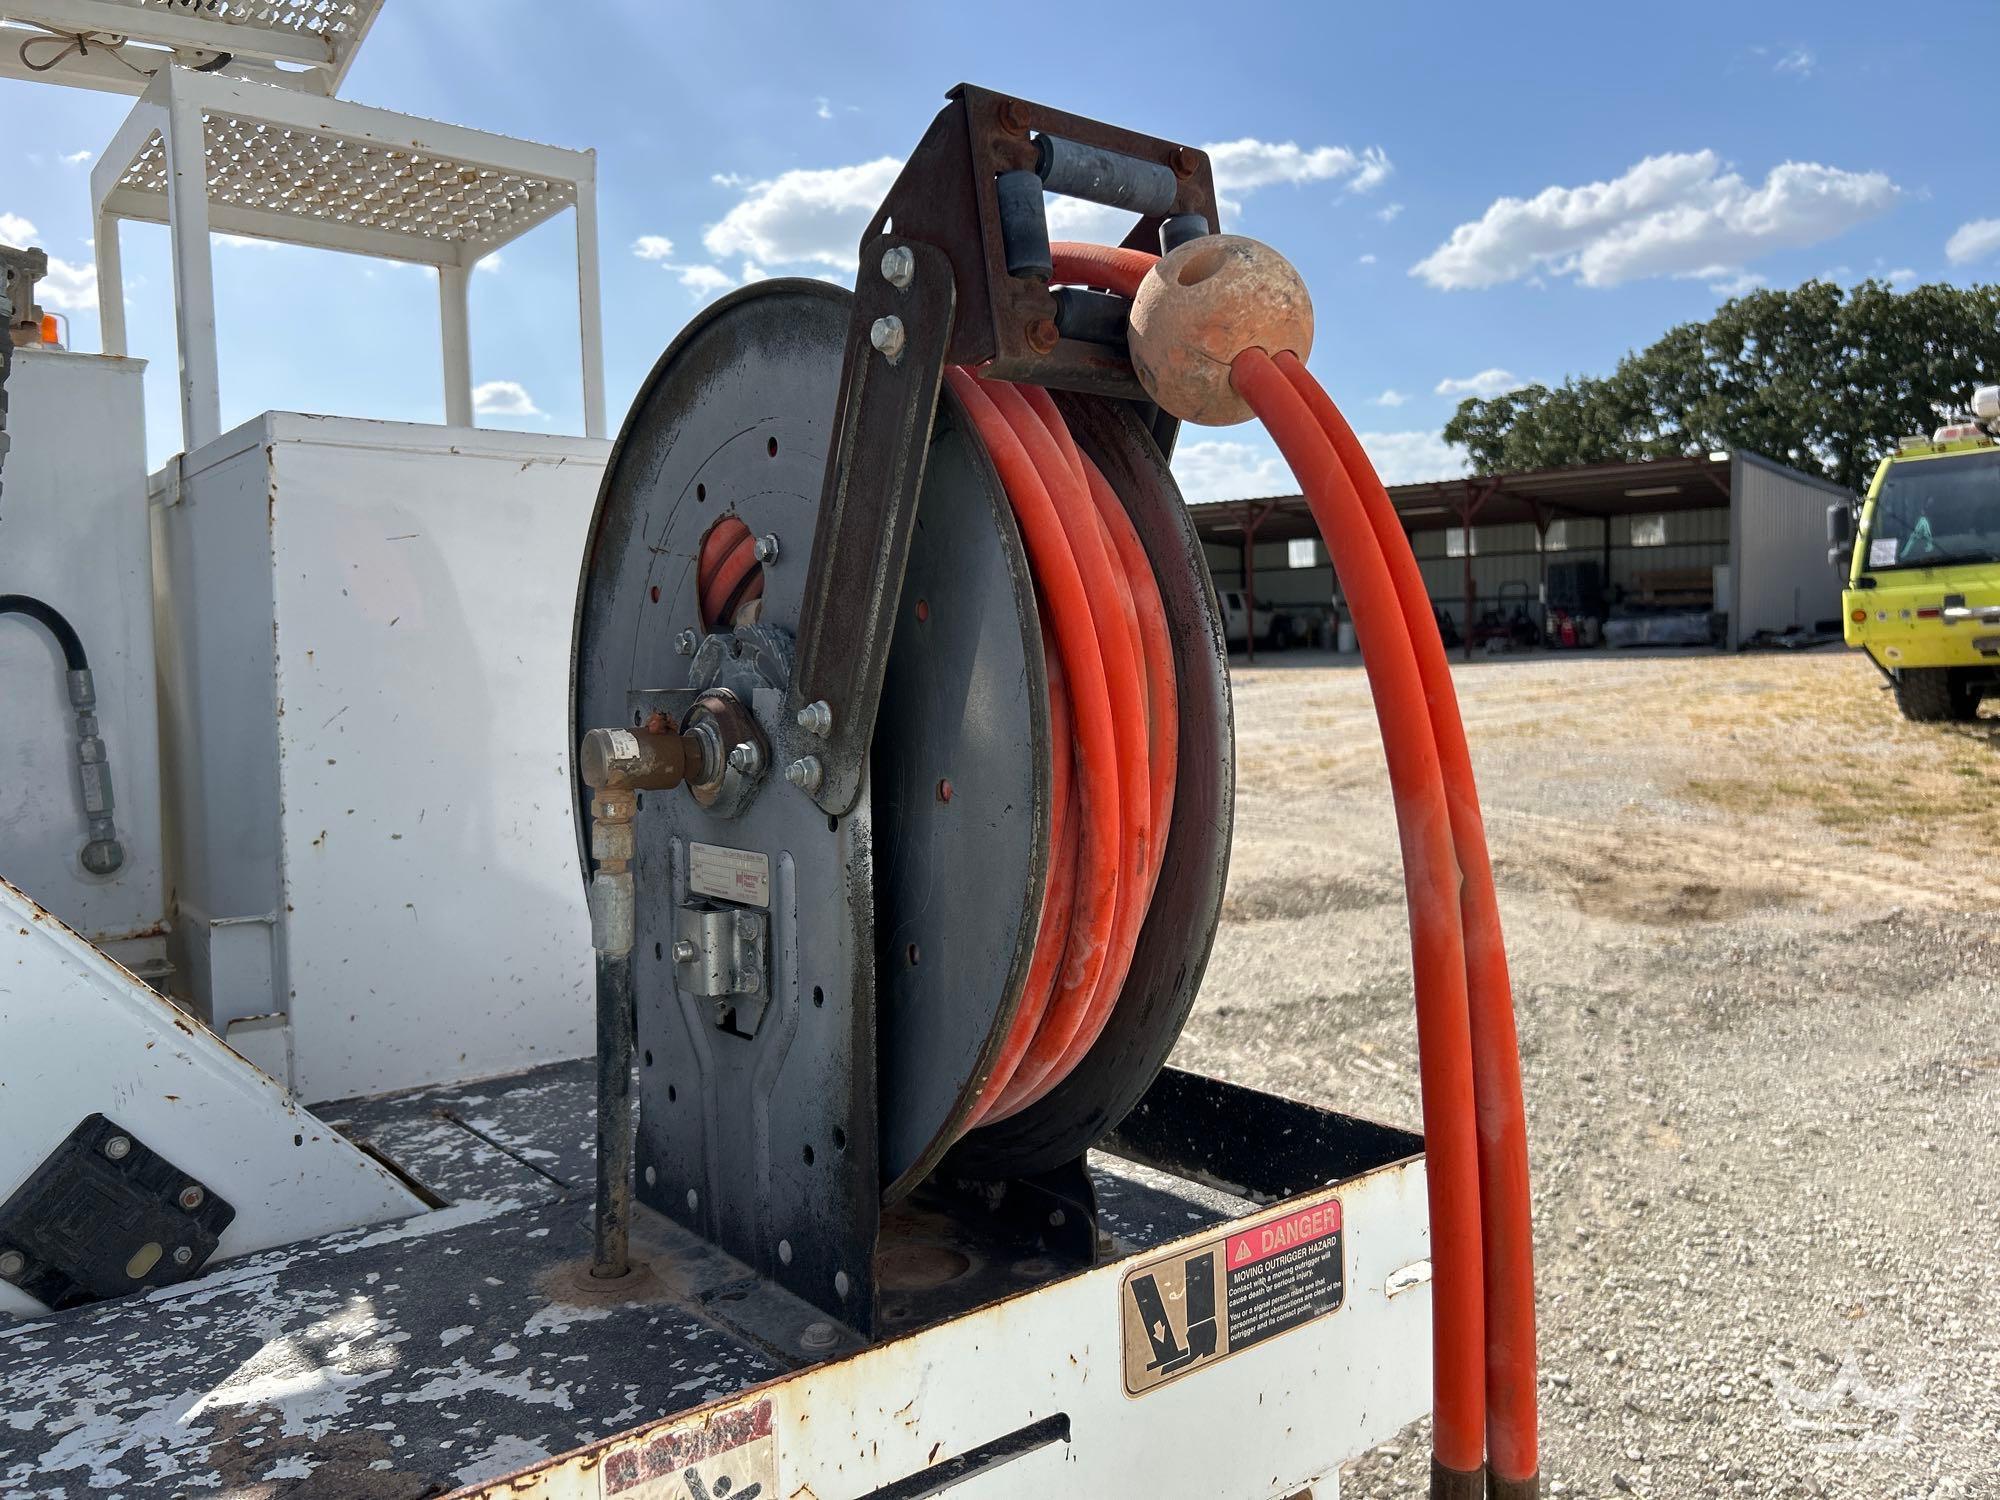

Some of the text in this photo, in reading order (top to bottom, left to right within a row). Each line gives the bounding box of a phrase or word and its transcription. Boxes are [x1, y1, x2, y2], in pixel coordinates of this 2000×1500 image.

[1261, 1207, 1335, 1254] DANGER
[1228, 1281, 1253, 1297] Contact
[1253, 1276, 1267, 1287] with
[1272, 1266, 1294, 1280] moving
[1295, 1254, 1321, 1271] outrigger
[1321, 1250, 1331, 1261] will
[1233, 1236, 1337, 1284] MOVING OUTRIGGER HAZARD
[1228, 1295, 1248, 1307] cause
[1248, 1287, 1265, 1300] death
[1266, 1285, 1273, 1293] or
[1273, 1276, 1296, 1290] serious
[1229, 1312, 1241, 1322] You
[1241, 1309, 1249, 1318] or
[1253, 1301, 1271, 1313] signal
[1271, 1293, 1291, 1306] person
[1290, 1287, 1305, 1297] must
[1305, 1283, 1315, 1292] see
[1315, 1277, 1326, 1287] that
[1229, 1315, 1259, 1333] personnel
[1258, 1309, 1270, 1320] and
[1270, 1297, 1304, 1315] obstructions
[1304, 1291, 1314, 1300] are
[1313, 1286, 1327, 1297] clear
[1326, 1283, 1333, 1292] of
[1333, 1280, 1342, 1290] the
[1230, 1325, 1257, 1341] outrigger
[1256, 1320, 1268, 1331] and
[1268, 1317, 1276, 1326] its
[1276, 1308, 1297, 1322] contact
